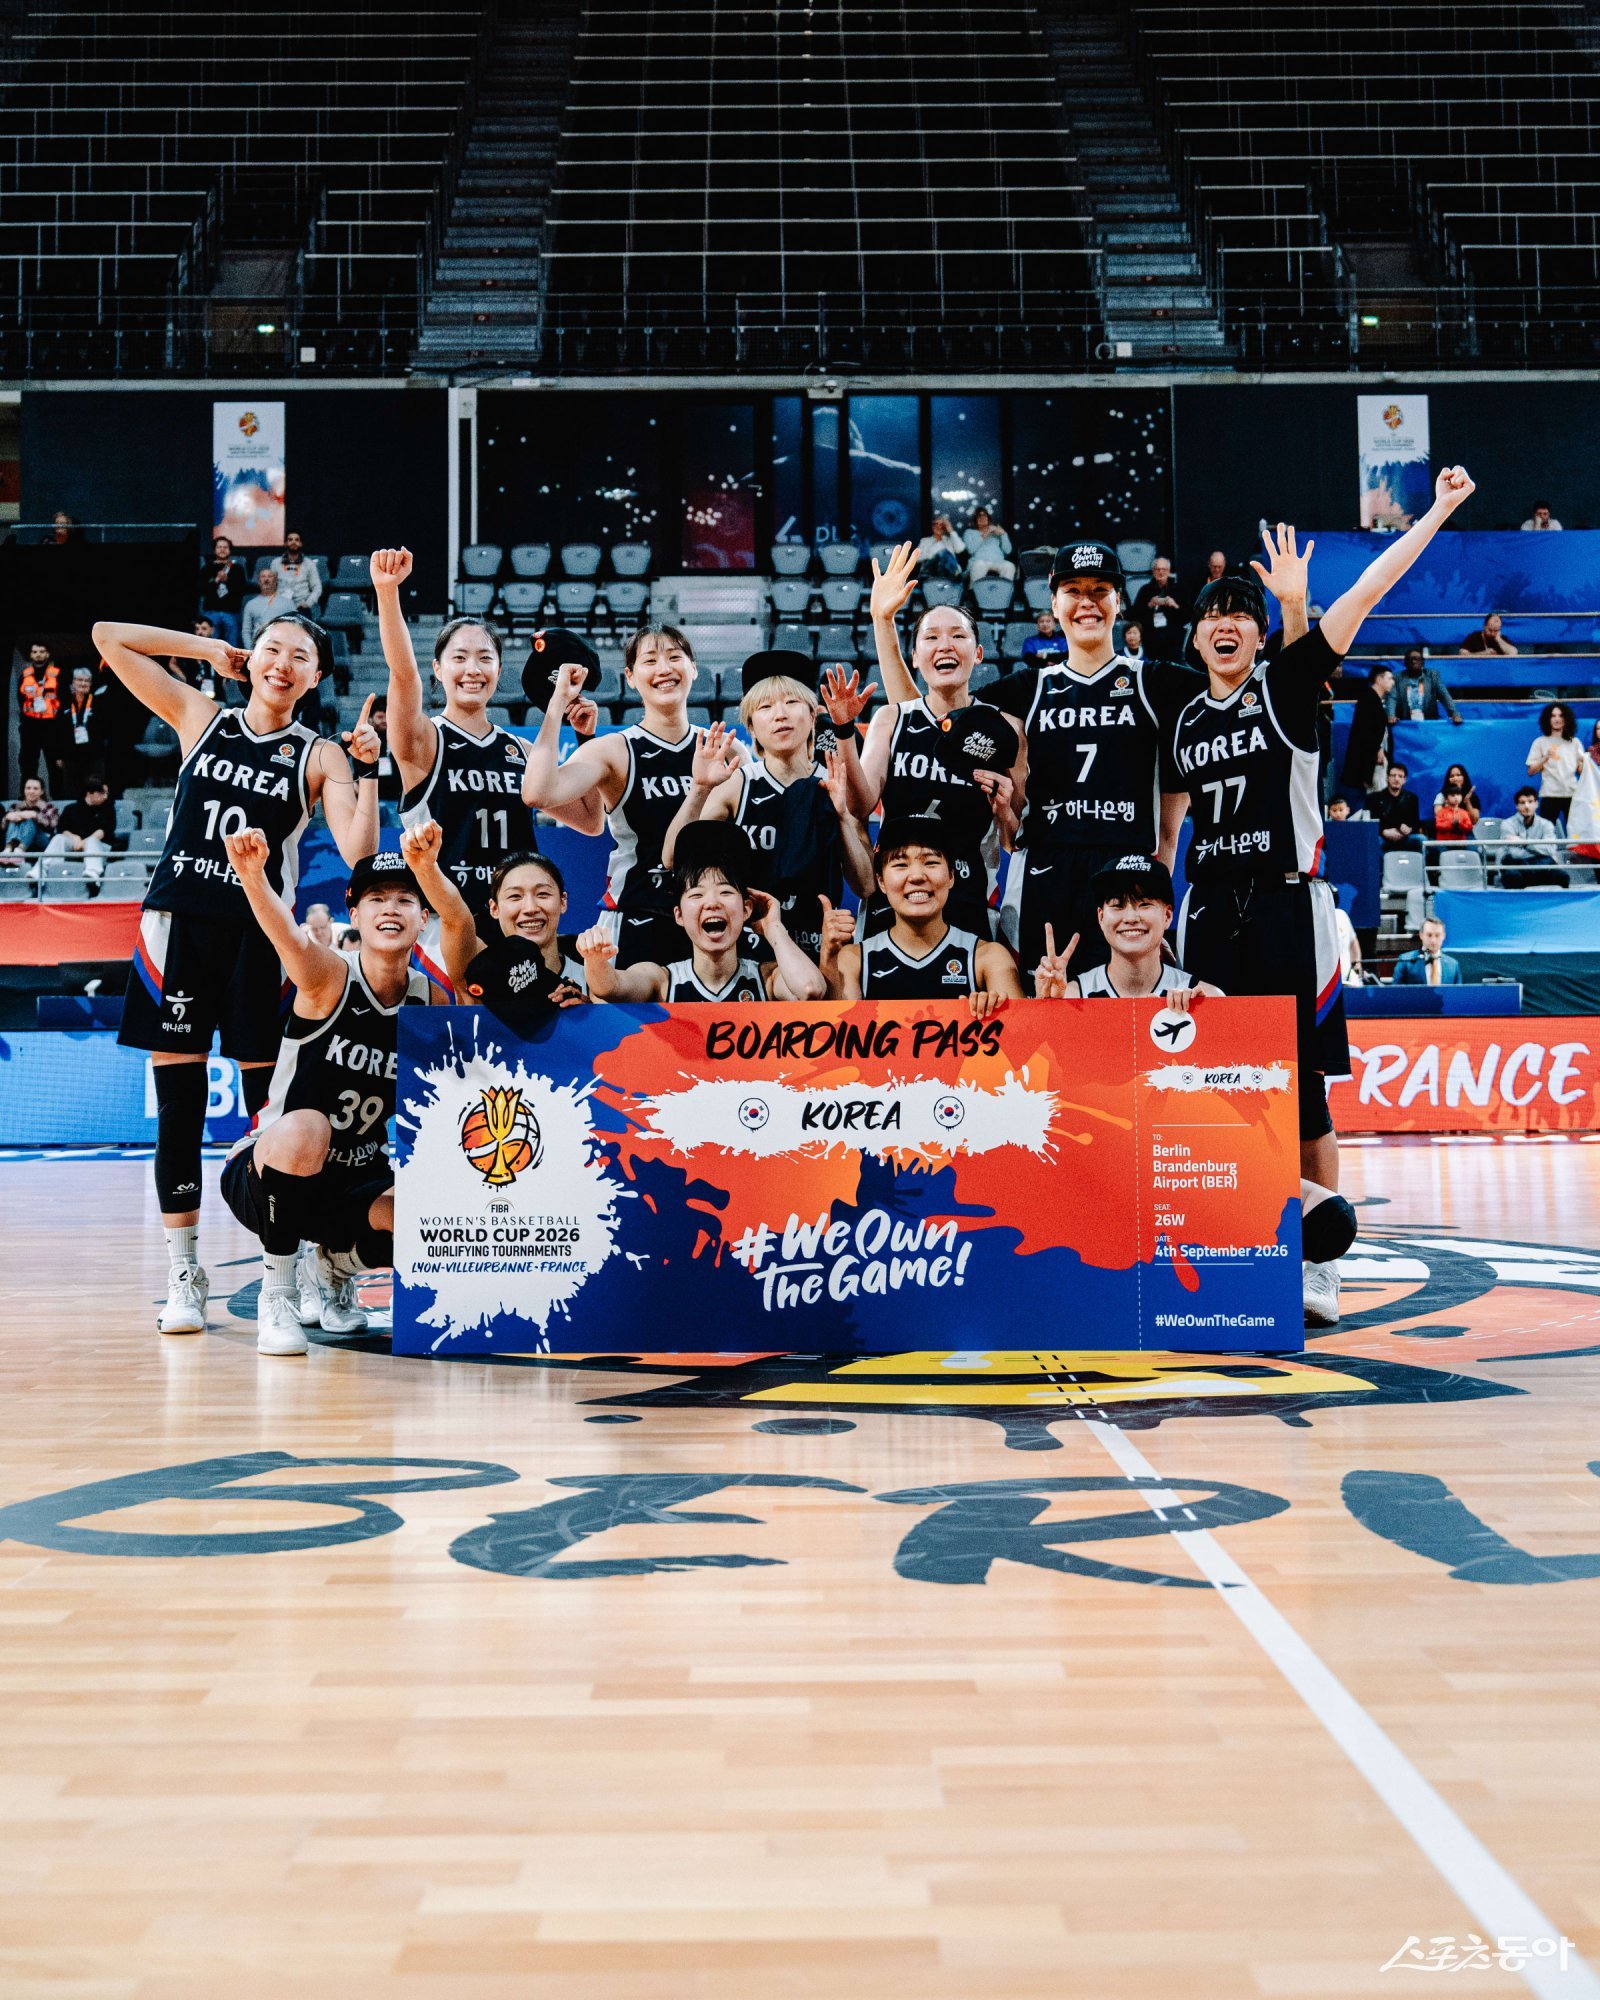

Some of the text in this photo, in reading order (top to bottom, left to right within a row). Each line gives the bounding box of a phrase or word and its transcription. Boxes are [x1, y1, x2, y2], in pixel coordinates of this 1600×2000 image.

[1075, 545, 1097, 555] #We
[1039, 704, 1136, 732] KOREA
[1180, 726, 1268, 773] KOREA
[1076, 743, 1097, 783] 7
[193, 753, 290, 802] KOREA
[448, 768, 525, 794] KORE
[641, 776, 694, 800] KOR
[1201, 775, 1247, 824] 77
[1065, 799, 1135, 823] 하나은행
[203, 800, 248, 844] 10
[475, 808, 508, 849] 11
[162, 1022, 192, 1033] 하나은행
[706, 1019, 1004, 1059] BOARDING PASS
[325, 1034, 398, 1080] KORE
[1204, 1073, 1241, 1084] KOREA
[329, 1089, 384, 1136] 39
[801, 1101, 901, 1130] KOREA
[1152, 1133, 1163, 1141] TO:
[1153, 1144, 1191, 1157] Berlin
[1153, 1160, 1238, 1175] Brandenburg
[1153, 1175, 1238, 1191] Airport (BER)
[491, 1204, 509, 1213] FIBA
[1154, 1203, 1171, 1211] SEAT:
[420, 1216, 580, 1226] WOMEN'S BASKETBALL
[1155, 1213, 1185, 1227] 26W
[420, 1227, 580, 1243] WORLD CUP 2026
[731, 1208, 958, 1269] #We Own
[1154, 1235, 1173, 1243] DATE:
[427, 1244, 572, 1257] QUALIFYING TOURNAMENTS
[1155, 1244, 1289, 1260] 4th September 2026
[753, 1241, 973, 1312] The Game!
[1155, 1314, 1275, 1327] #WeOwnTheGame
